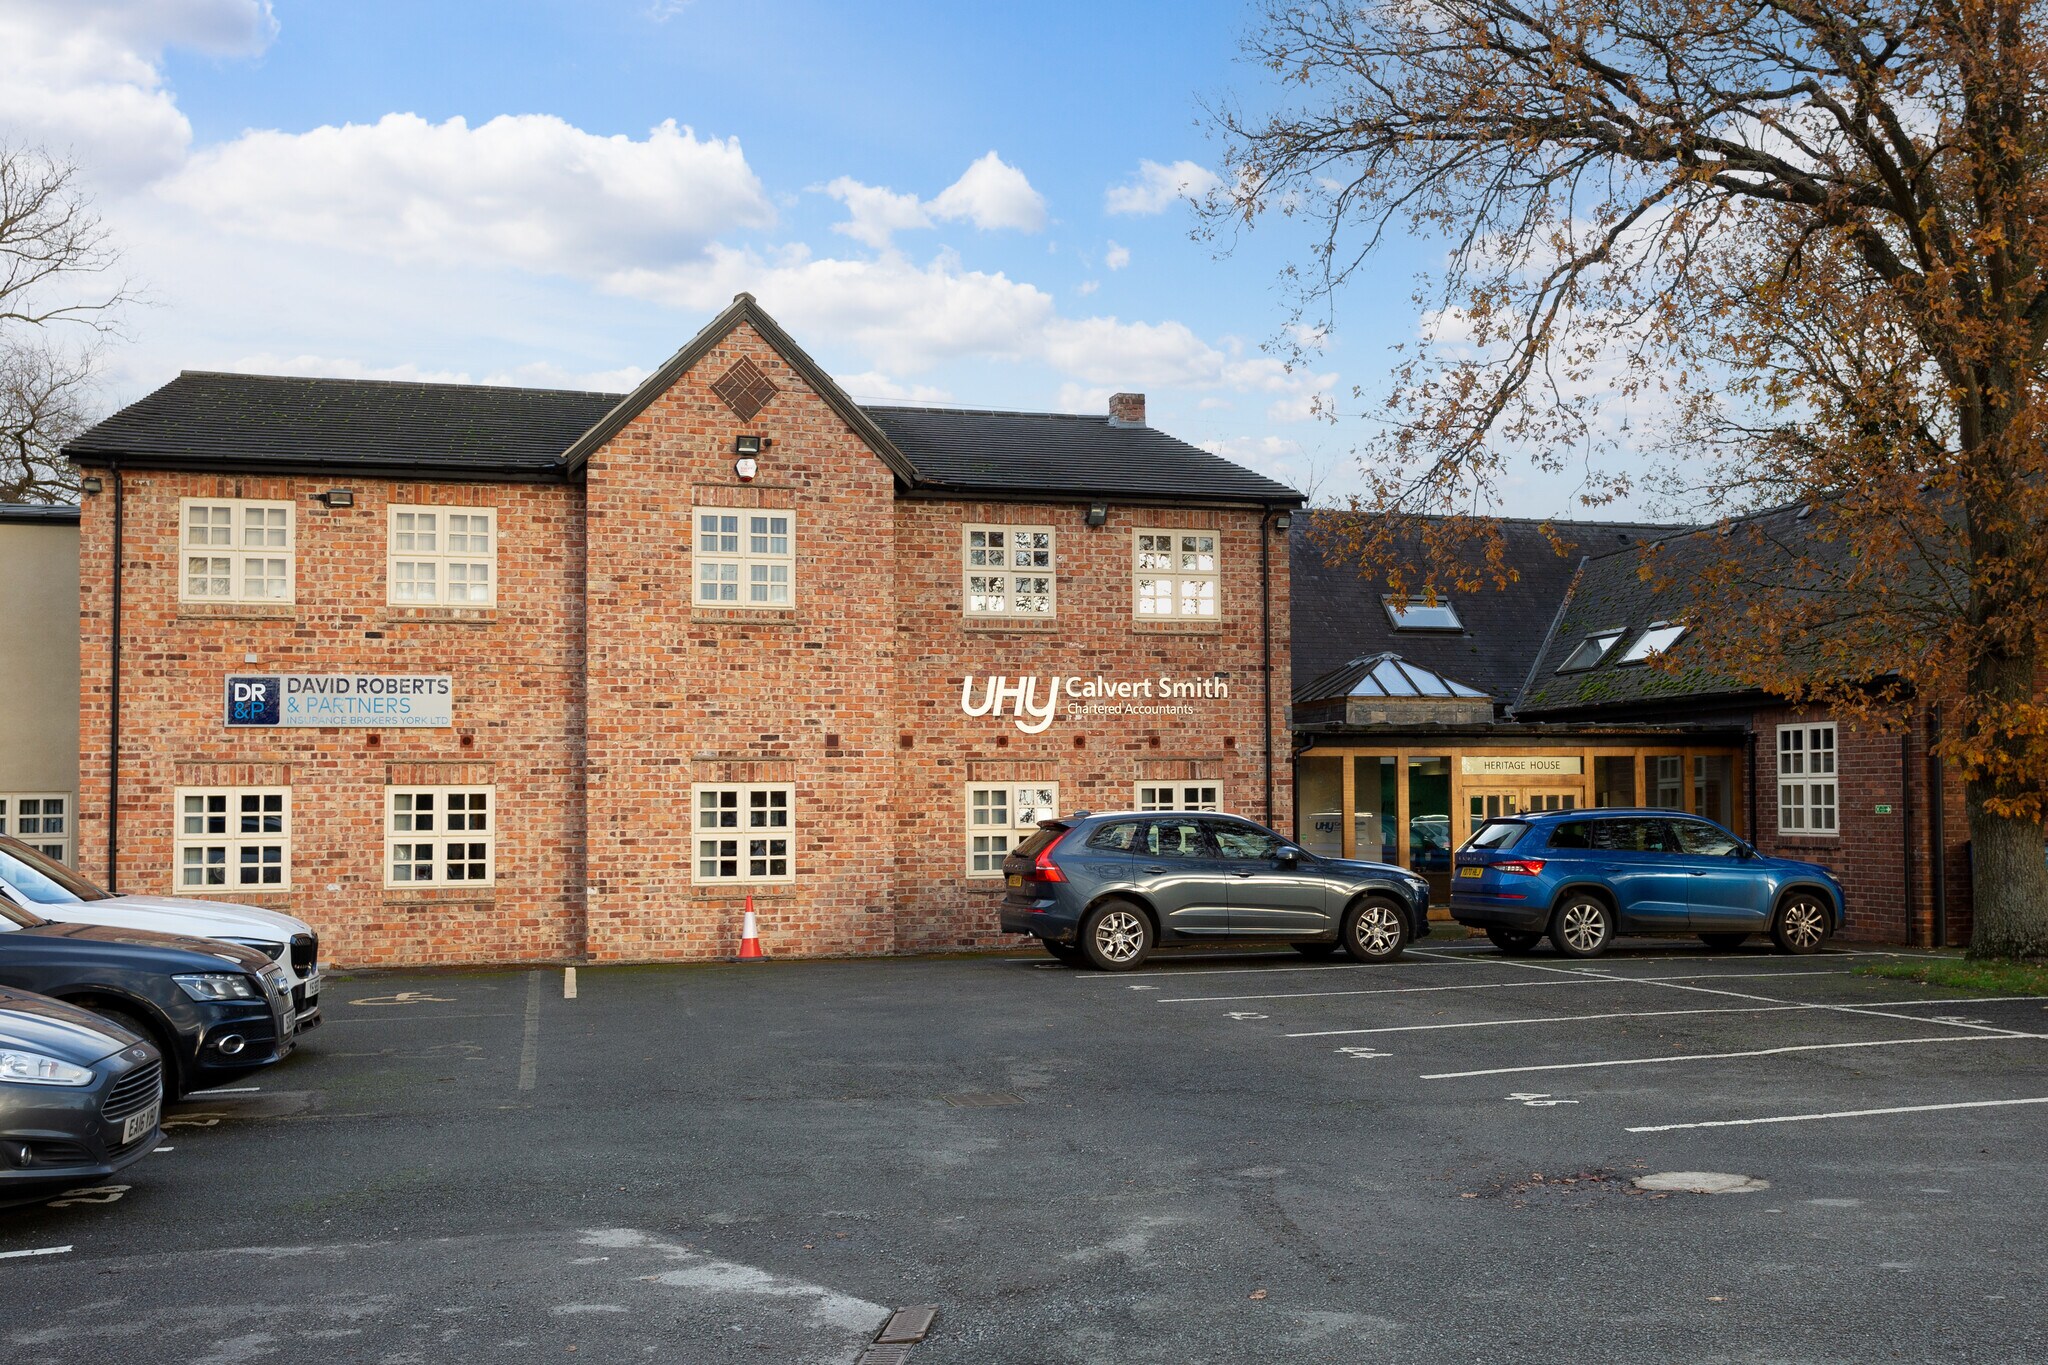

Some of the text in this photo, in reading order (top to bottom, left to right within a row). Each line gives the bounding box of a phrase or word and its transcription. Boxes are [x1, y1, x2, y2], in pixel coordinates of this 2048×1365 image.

[234, 683, 266, 702] DR
[287, 677, 449, 695] DAVID ROBERTS
[1065, 675, 1229, 699] Calvert Smith
[234, 701, 265, 719] &P
[287, 697, 411, 713] & PARTNERS
[1067, 702, 1193, 715] Chartered Accountants
[286, 716, 448, 725] INSURANCE BROKERS YORK LTD
[1484, 761, 1561, 770] HERITAGE HOUSE
